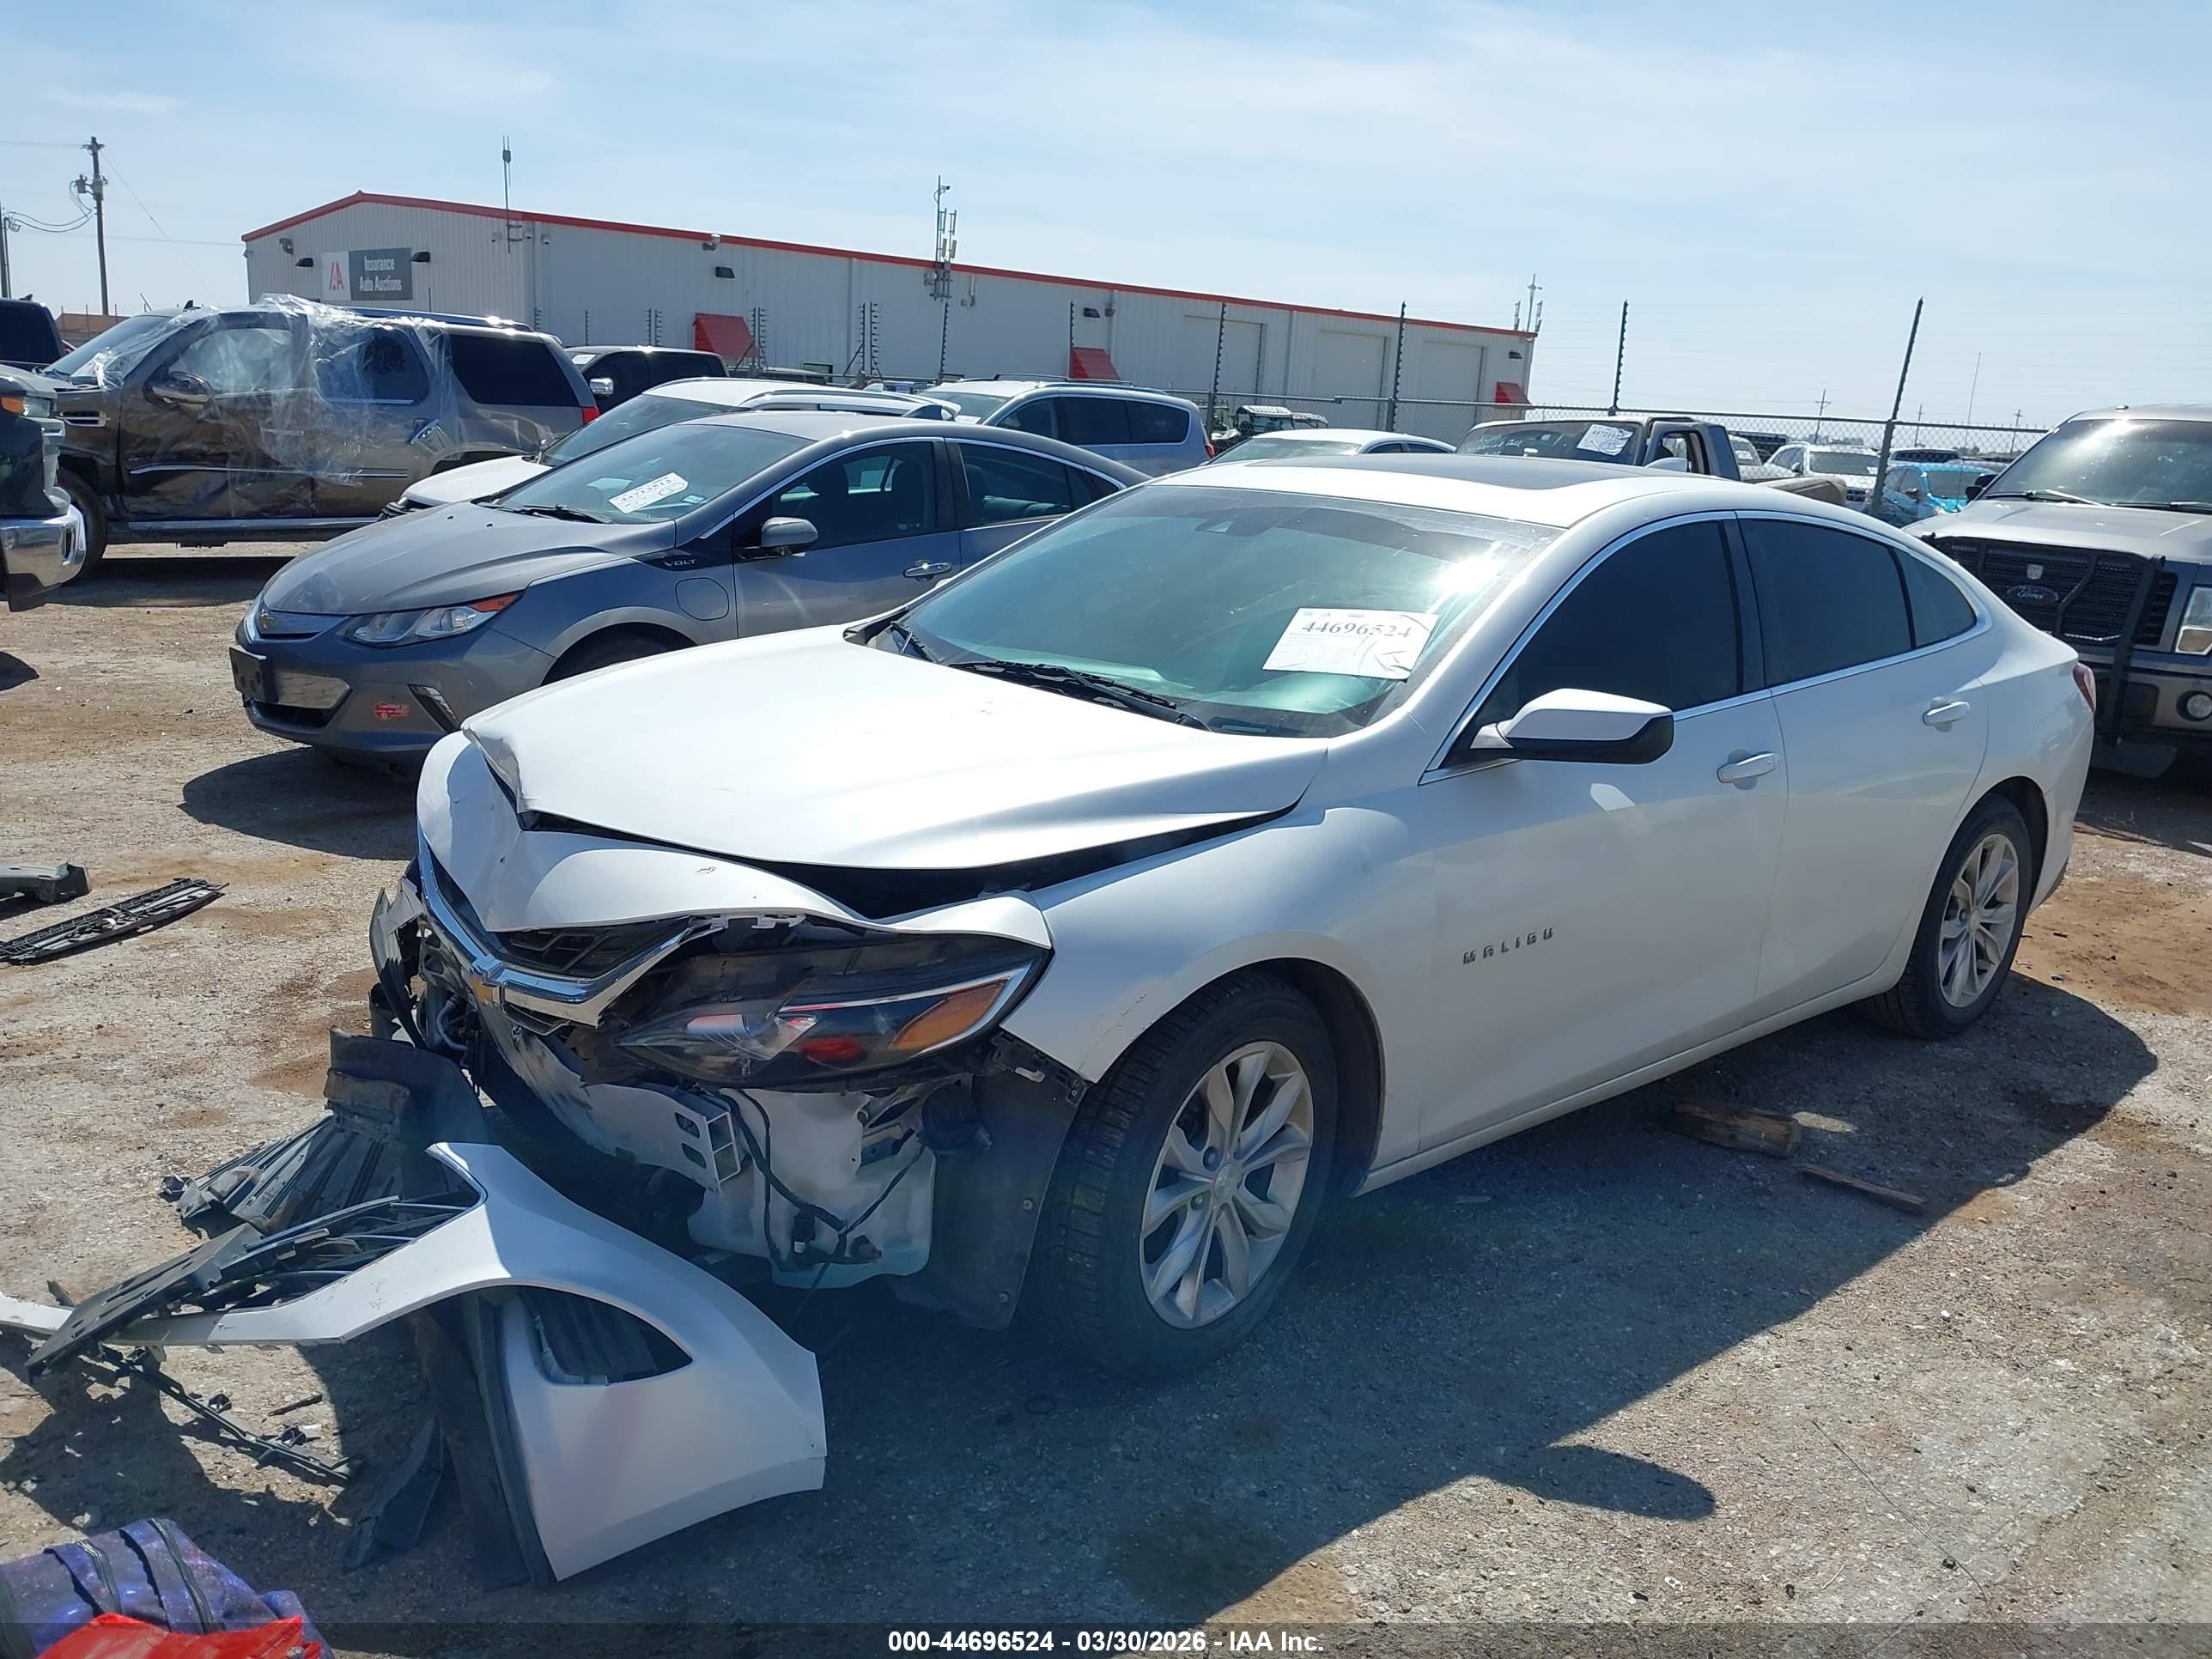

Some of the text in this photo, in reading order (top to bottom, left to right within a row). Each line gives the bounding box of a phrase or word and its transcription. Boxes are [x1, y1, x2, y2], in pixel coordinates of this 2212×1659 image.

[364, 256, 395, 271] Insurance
[359, 275, 402, 292] Auto Auctions
[1300, 621, 1413, 639] 44696524
[1462, 927, 1553, 964] MALIBU
